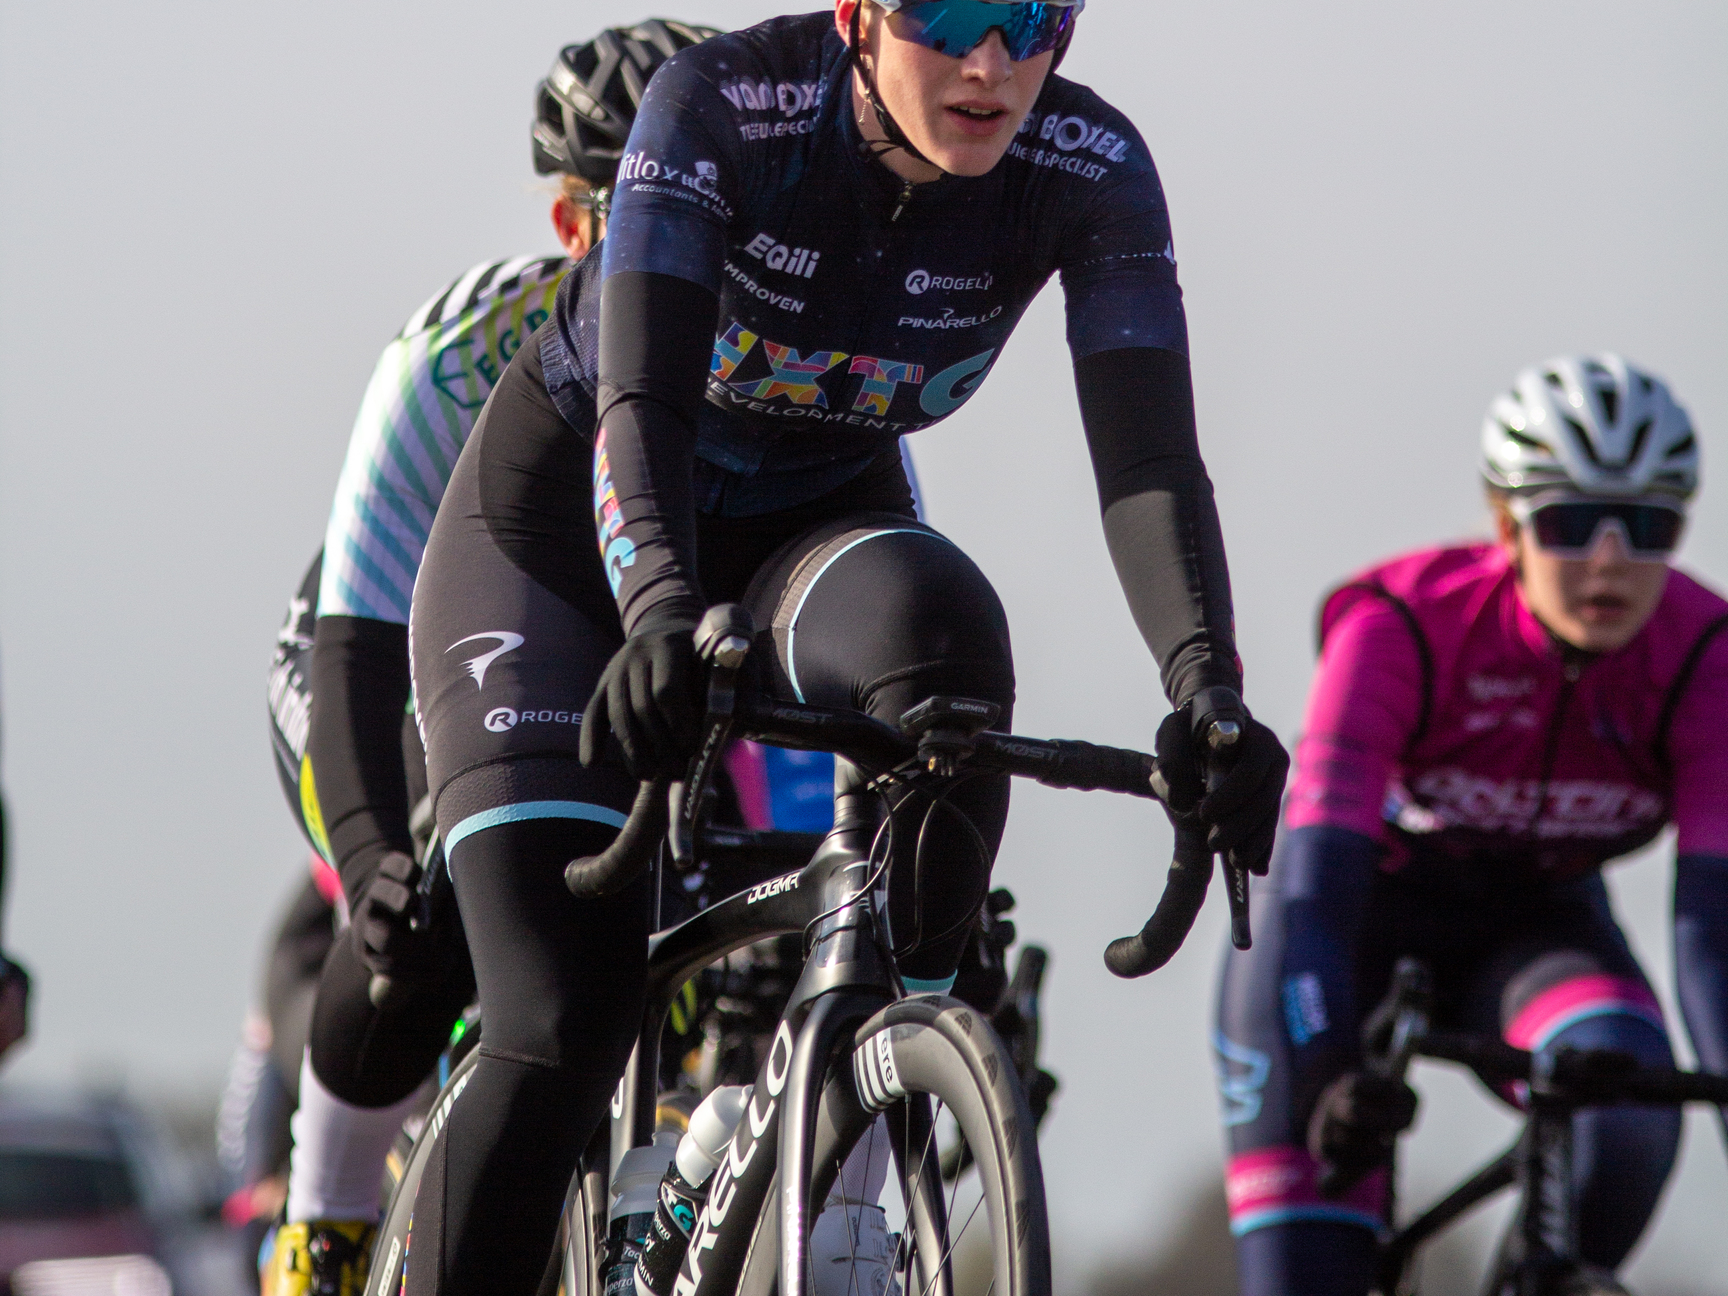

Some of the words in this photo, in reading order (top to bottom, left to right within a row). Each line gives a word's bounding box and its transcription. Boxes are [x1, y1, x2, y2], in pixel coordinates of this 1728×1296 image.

[723, 259, 805, 314] MPROVEN
[897, 305, 1002, 330] PINARELLO
[707, 378, 906, 431] EVELOPMENT
[950, 702, 988, 714] GARMIN
